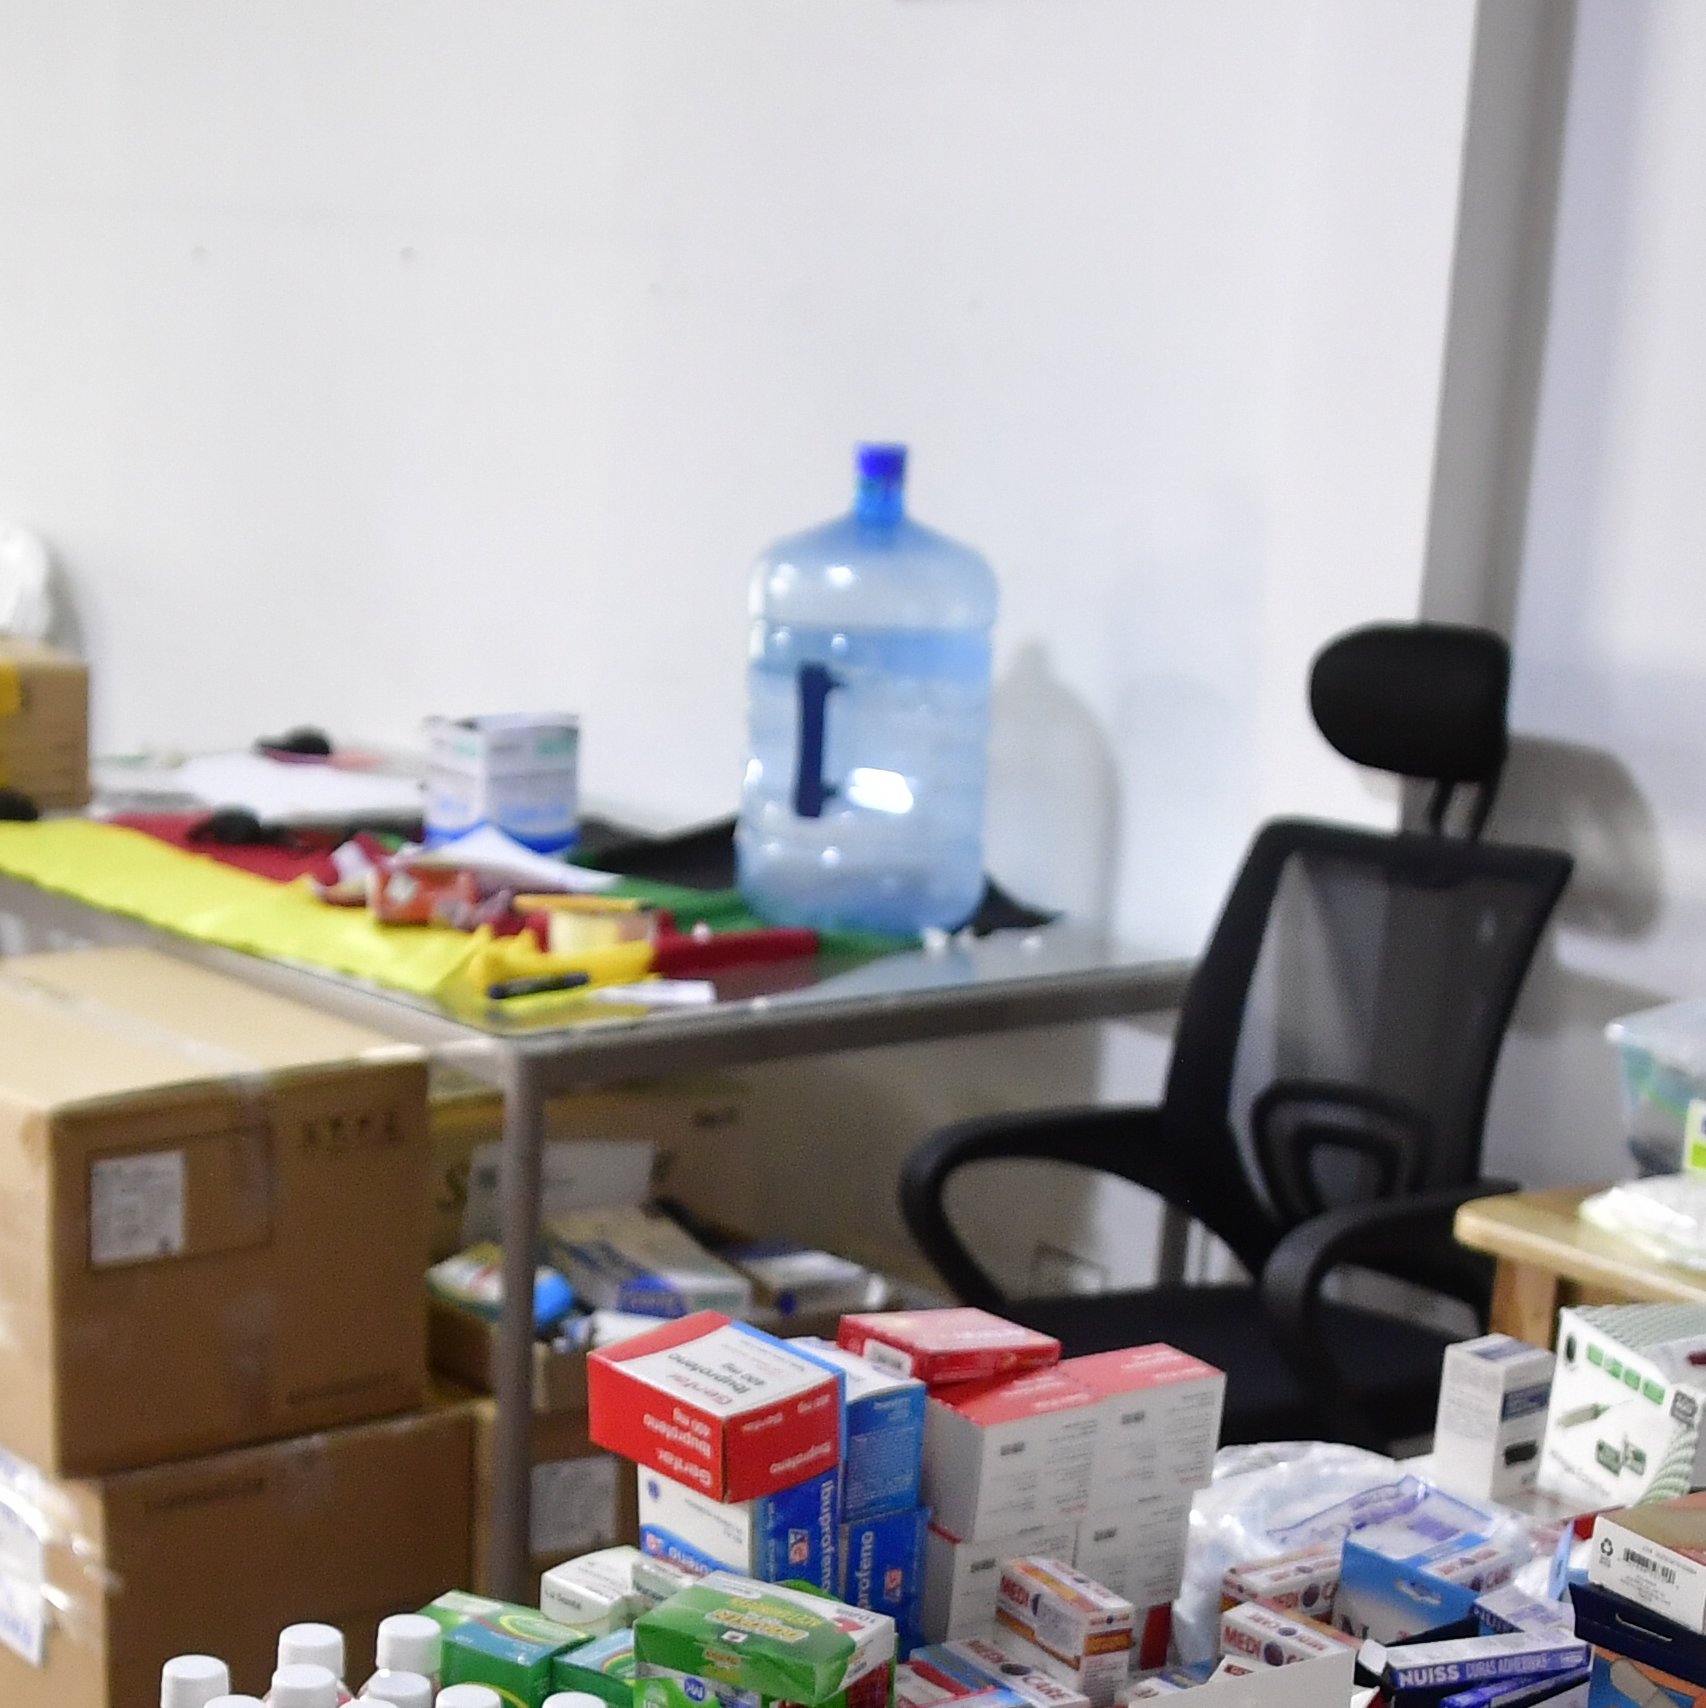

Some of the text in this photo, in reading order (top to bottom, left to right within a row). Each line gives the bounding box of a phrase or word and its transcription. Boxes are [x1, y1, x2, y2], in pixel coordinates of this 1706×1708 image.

[1223, 1622, 1262, 1655] MEDI
[1021, 1673, 1071, 1702] CARE
[1399, 1664, 1460, 1689] NUISS
